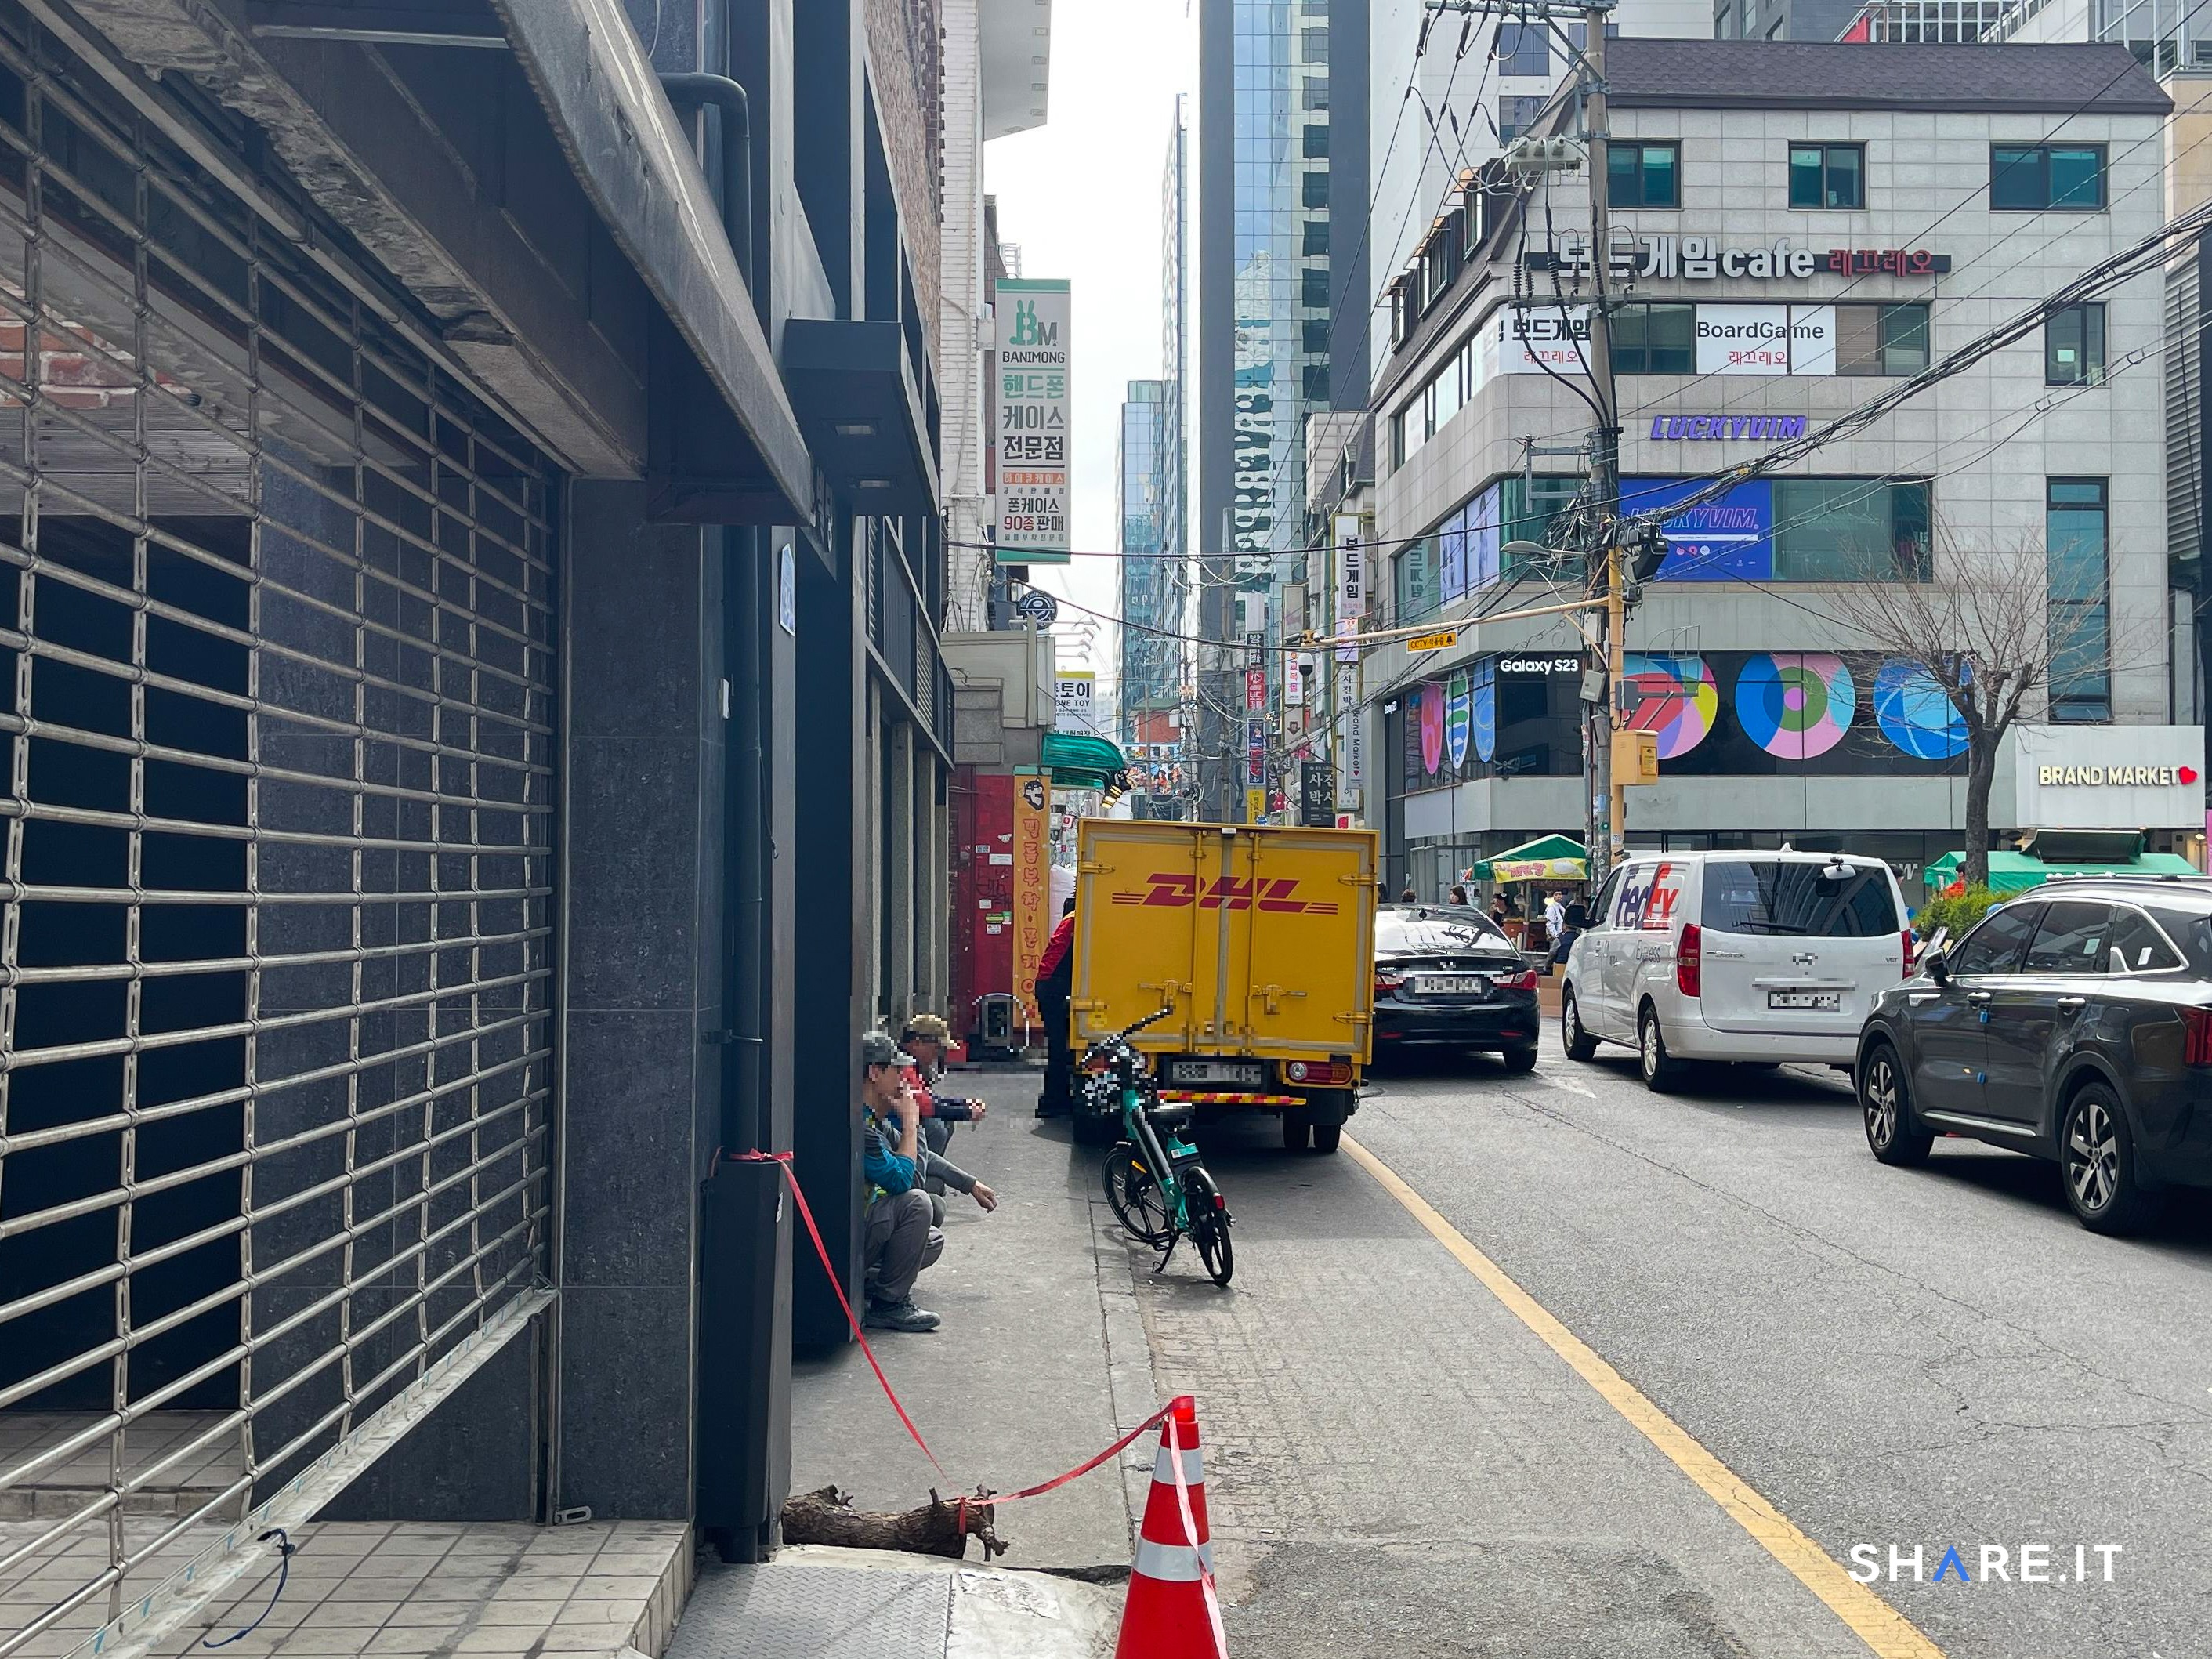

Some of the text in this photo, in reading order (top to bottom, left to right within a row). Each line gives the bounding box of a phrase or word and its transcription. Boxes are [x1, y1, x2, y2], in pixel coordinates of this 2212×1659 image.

[1828, 249, 1935, 277] 레끄레오
[1512, 318, 1592, 342] 보드게임
[1697, 321, 1824, 339] BoardGame
[1002, 351, 1066, 363] BANIMONG
[1729, 351, 1787, 365] 레끄레오
[1003, 375, 1064, 399] 핸드폰
[1003, 405, 1064, 429] 케이스
[1650, 415, 1807, 440] LUCKYVIM
[1004, 436, 1063, 460] 전문점
[1008, 498, 1059, 513] 폰케이스
[1004, 516, 1064, 531] 90종 판매
[1346, 538, 1359, 598] 보드게임
[1410, 639, 1428, 649] CCTV
[1500, 659, 1578, 675] Galaxy S23
[1055, 683, 1090, 698] 토이
[2039, 766, 2178, 786] BRAND MARKET
[1142, 873, 1309, 913] DHL
